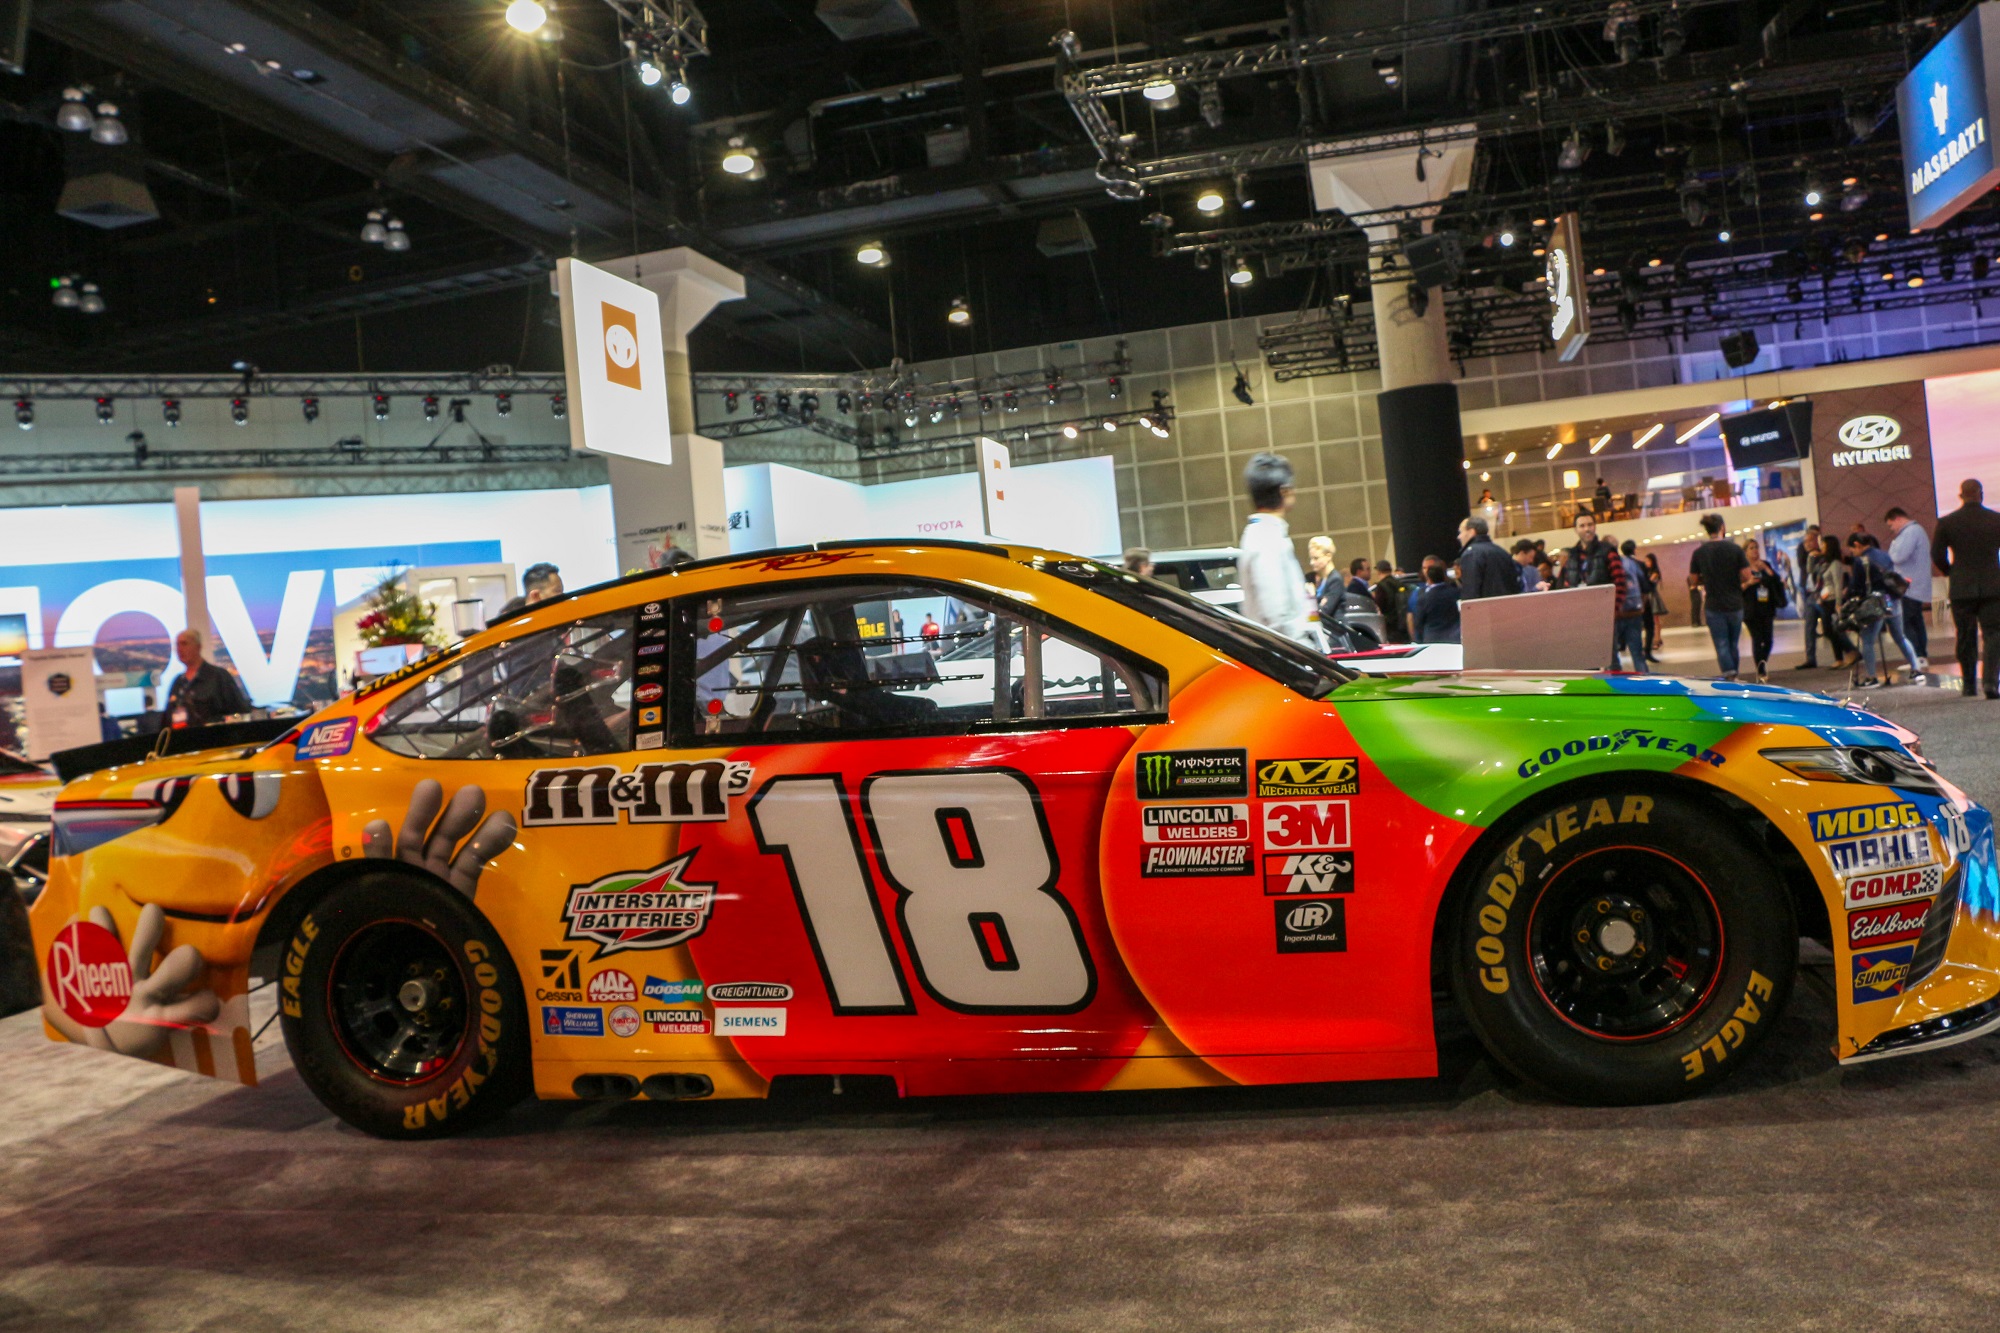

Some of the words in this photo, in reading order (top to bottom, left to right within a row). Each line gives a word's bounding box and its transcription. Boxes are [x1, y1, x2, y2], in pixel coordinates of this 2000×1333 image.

[1912, 117, 1985, 195] MASERATI
[1832, 444, 1912, 468] HYUNDAI
[917, 519, 964, 533] TOYOTA
[641, 612, 664, 621] TOYOTA
[308, 721, 352, 746] NOS
[1183, 776, 1207, 784] NASCAR
[1208, 775, 1220, 783] CUP
[1220, 775, 1241, 783] SERIES
[1259, 784, 1320, 797] MECHANIX
[1321, 782, 1357, 795] WEAR
[1147, 808, 1229, 825] LINCOLN
[1266, 803, 1347, 847] 3M
[1816, 803, 1922, 839] MOOG
[1166, 826, 1239, 839] WELDERS
[1145, 846, 1248, 874] FLOWMASTER
[1829, 830, 1931, 872] MAHLE
[745, 766, 1098, 1016] 18
[1850, 871, 1922, 901] COMP
[1902, 885, 1935, 897] CAMS
[576, 892, 704, 911] INTERSTATE
[579, 910, 697, 929] BATTERIES
[1292, 907, 1324, 927] IR
[1851, 908, 1929, 941] Edelbrock
[1284, 934, 1315, 944] Ingersoll
[1316, 933, 1336, 942] Rand
[53, 921, 131, 1013] Rheem
[282, 912, 321, 1019] EAGLE
[589, 970, 635, 993] MAC
[1856, 965, 1909, 986] SUNOCO
[535, 988, 583, 1002] Cessna
[590, 992, 636, 1002] TOOLS
[643, 984, 703, 995] DOOSAN
[715, 986, 785, 997] FREIGHTLINER
[563, 1019, 598, 1028] WILLIAMS
[565, 1011, 597, 1020] SHERWIN
[646, 1011, 701, 1022] LINCOLN
[723, 1016, 778, 1027] SIEMENS
[1681, 969, 1774, 1081] EAGLE
[658, 1024, 705, 1033] WELDERS
